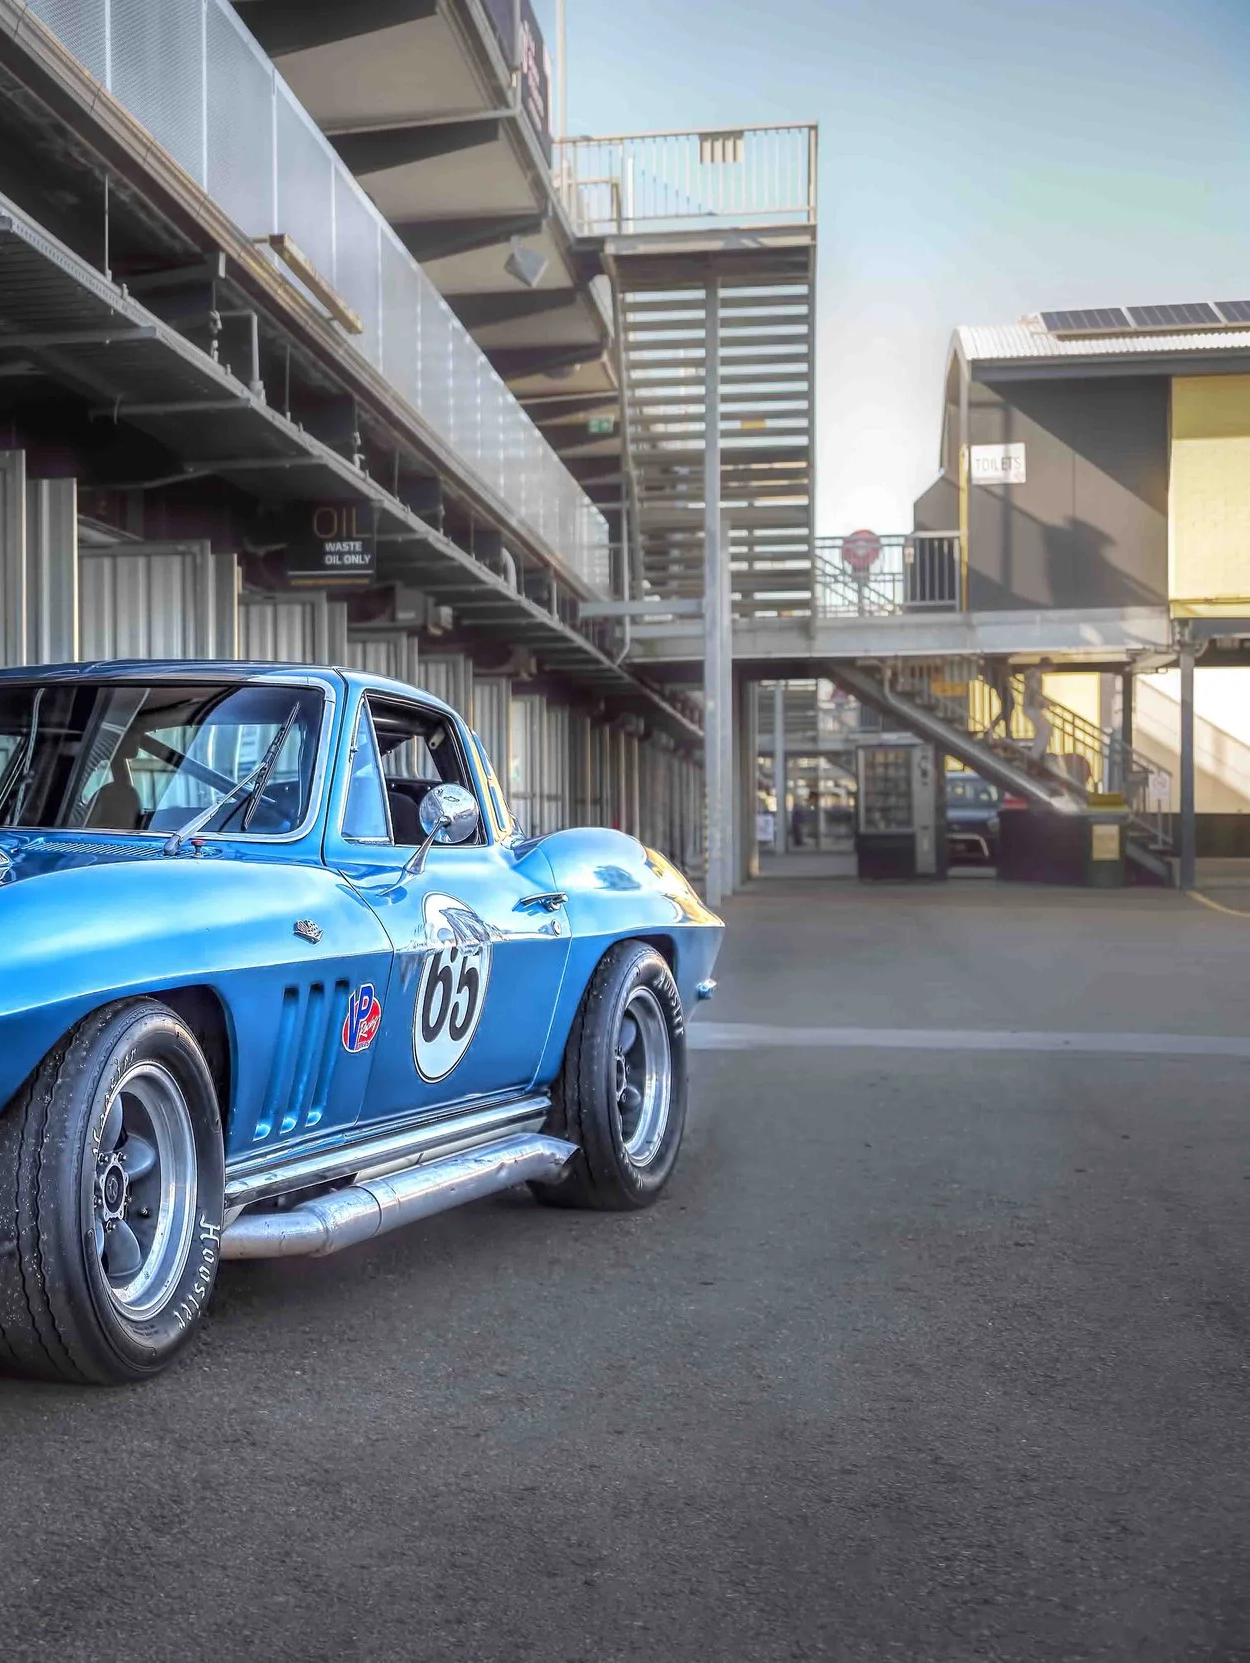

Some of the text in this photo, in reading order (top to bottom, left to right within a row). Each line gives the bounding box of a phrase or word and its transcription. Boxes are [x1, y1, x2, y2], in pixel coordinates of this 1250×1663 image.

[975, 455, 1022, 472] TOILETS
[313, 507, 372, 539] OIL
[324, 541, 363, 552] WASTE
[324, 554, 372, 565] OIL ONLY
[422, 947, 480, 1043] 65
[348, 985, 375, 1051] VP
